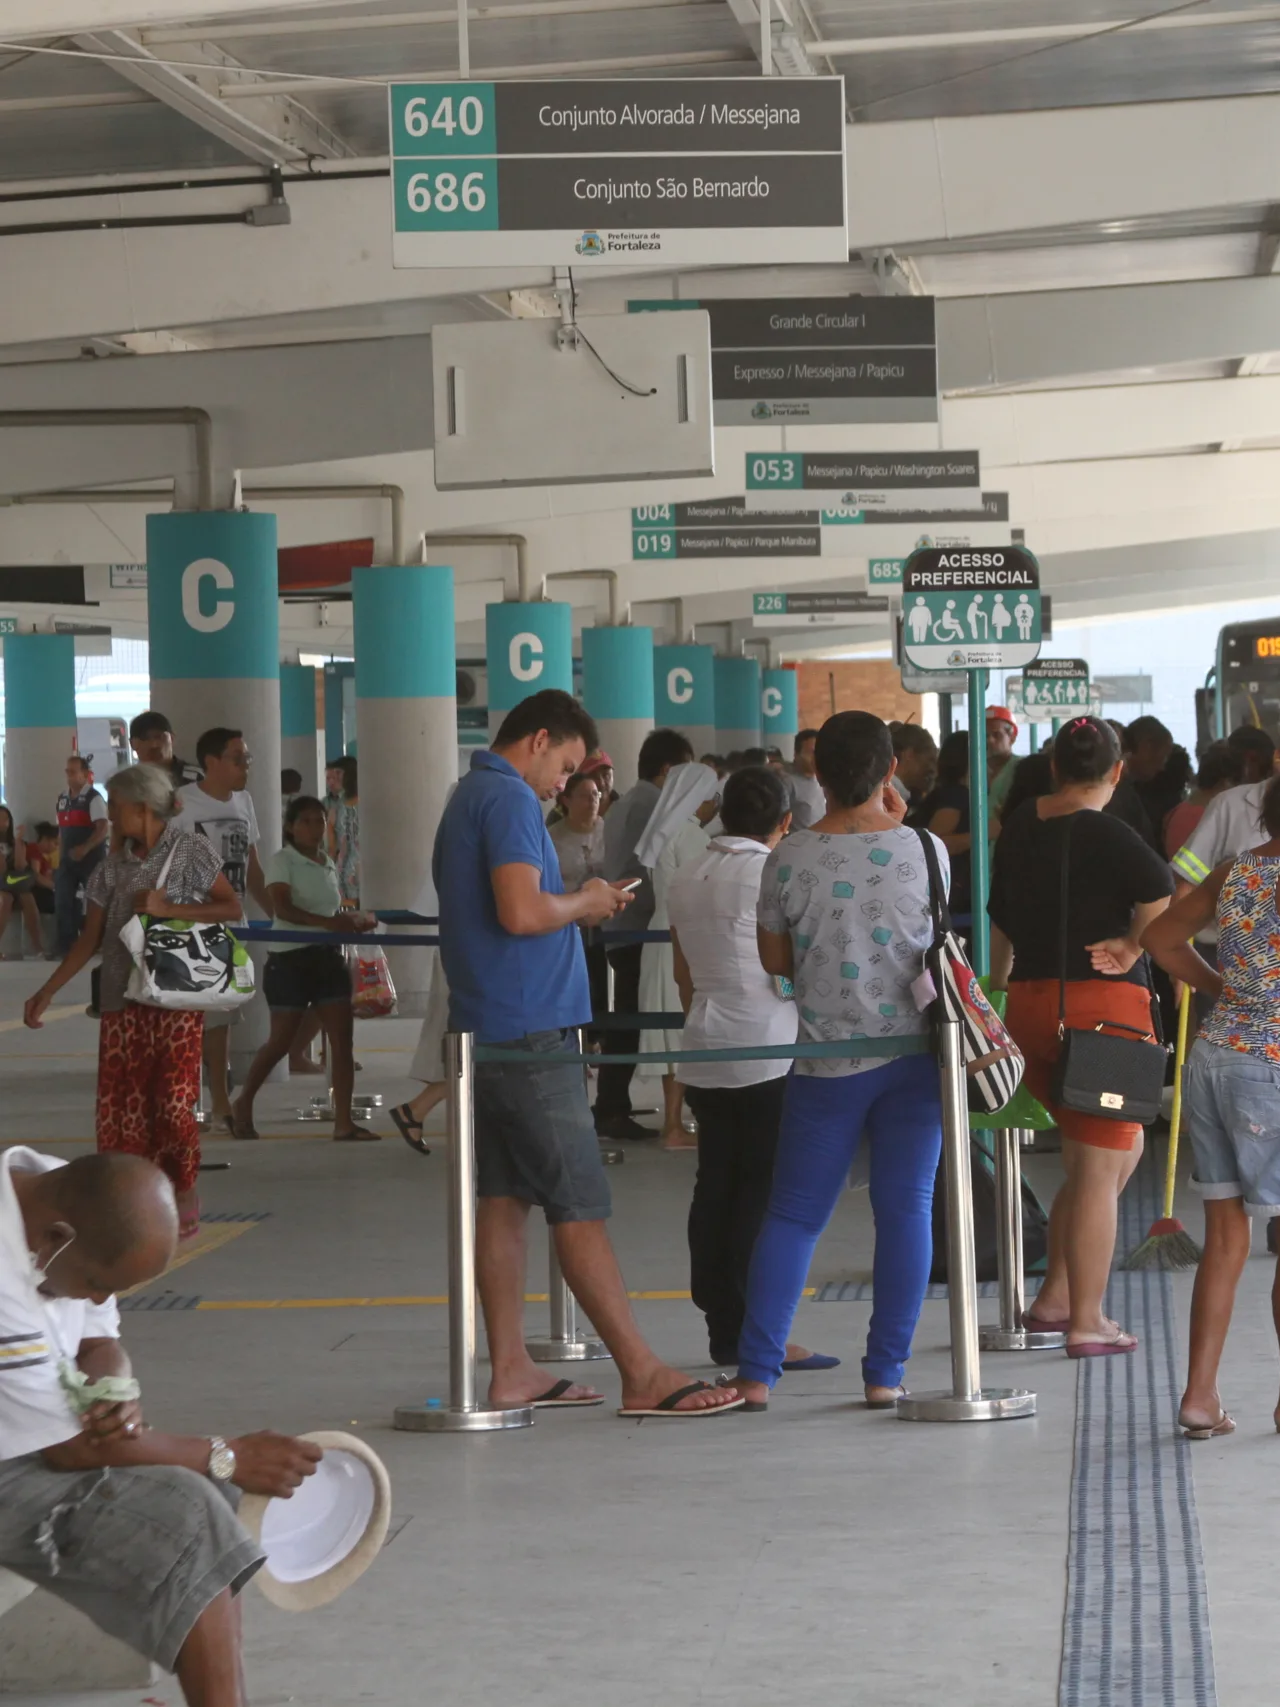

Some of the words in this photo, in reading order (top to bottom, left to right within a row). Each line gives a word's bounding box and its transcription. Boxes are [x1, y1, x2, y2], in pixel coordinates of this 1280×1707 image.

[404, 96, 484, 137] 640
[539, 105, 617, 131] Conjunto
[620, 104, 695, 125] Alvorada
[699, 104, 706, 124] /
[711, 104, 800, 129] Messejana
[406, 172, 486, 212] 686
[574, 178, 651, 204] Conjunto
[656, 177, 687, 198] São
[693, 176, 769, 197] Bernardo
[608, 241, 661, 251] Fortaleza
[769, 314, 812, 329] Grande
[815, 313, 859, 328] Circular
[734, 365, 784, 382] Expresso
[787, 365, 792, 379] /
[795, 363, 856, 382] Messejana
[859, 364, 864, 378] /
[867, 363, 904, 380] Papicu
[753, 459, 795, 481] 053
[807, 465, 852, 479] Messejana
[860, 464, 888, 478] Papicu
[894, 464, 946, 479] Washington
[948, 464, 975, 476] Soares
[637, 503, 670, 520] 004
[637, 534, 671, 553] 019
[681, 538, 719, 550] Messejana
[725, 537, 749, 549] Papicu
[938, 553, 1005, 567] ACESSO
[873, 562, 901, 578] 685
[911, 571, 1033, 586] PREFERENCIAL
[181, 558, 235, 633] C
[758, 596, 782, 610] 226
[509, 632, 544, 681] C
[968, 656, 1002, 664] Fortaleza
[1041, 661, 1074, 669] ACESSO
[1027, 669, 1086, 678] PREFERENCIAL
[667, 667, 694, 704] C
[762, 687, 783, 717] C
